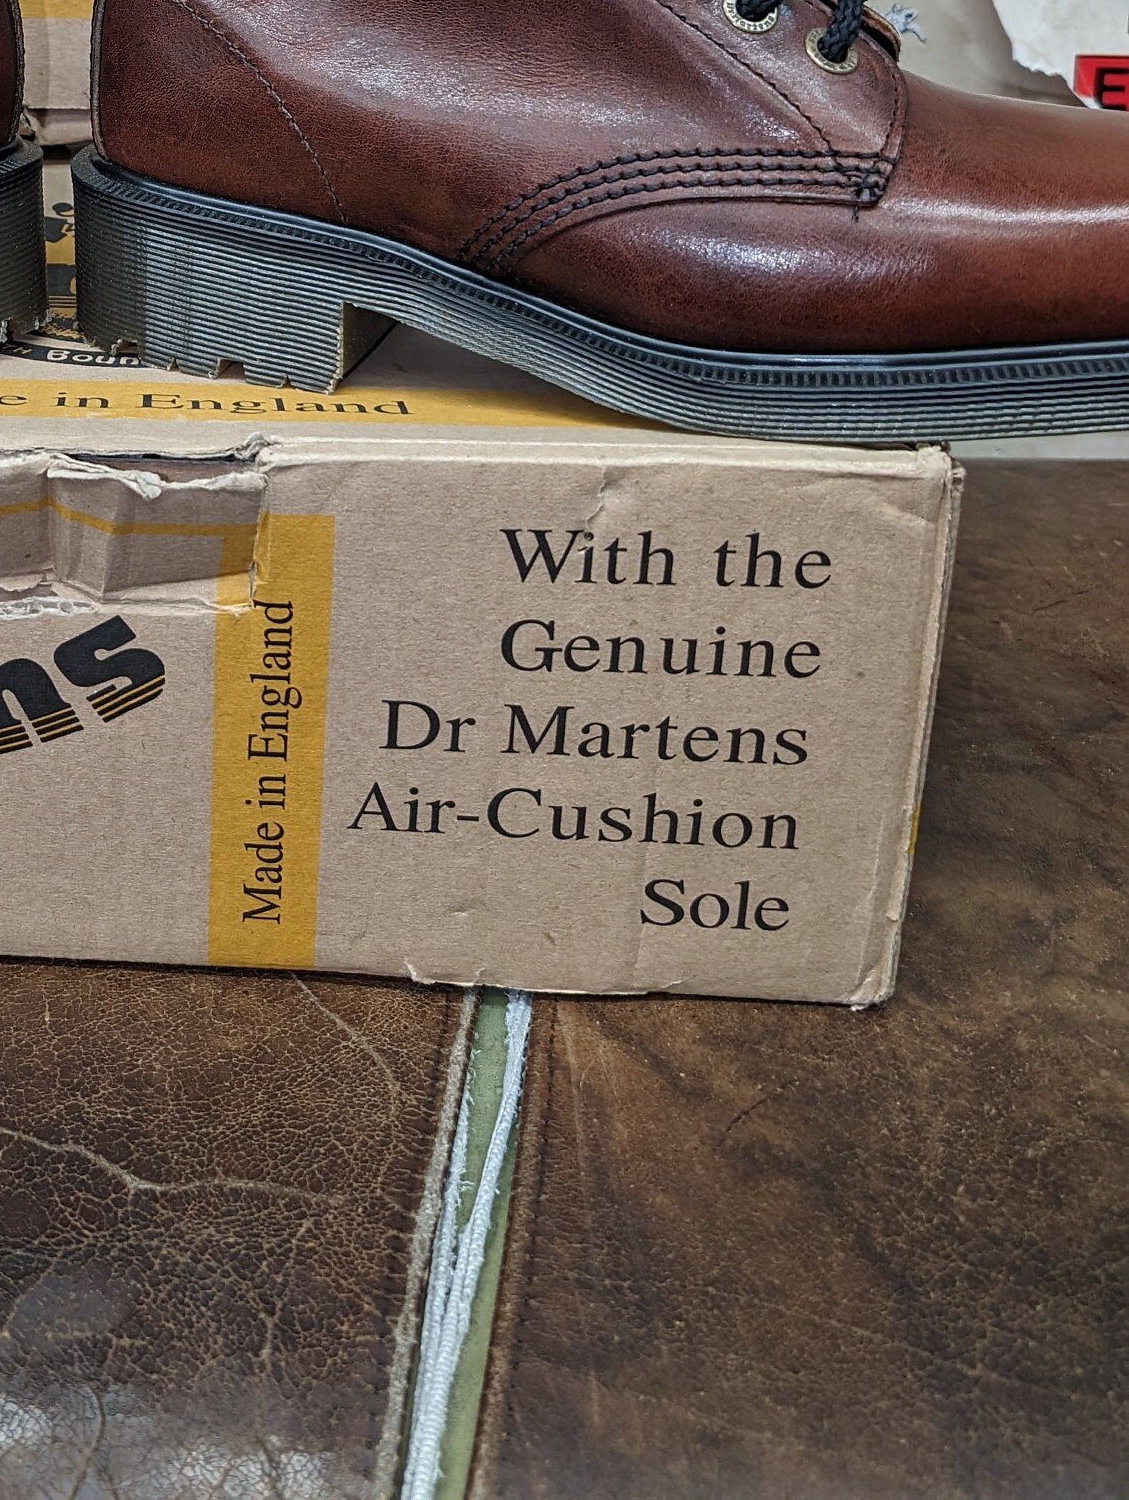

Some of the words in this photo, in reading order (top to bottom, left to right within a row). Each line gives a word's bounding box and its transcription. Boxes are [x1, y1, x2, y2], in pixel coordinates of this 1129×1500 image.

[55, 391, 110, 409] in
[137, 393, 414, 416] England
[499, 528, 677, 586] With
[712, 531, 833, 590] the
[500, 618, 822, 679] Genuine
[247, 599, 303, 762] England
[378, 699, 477, 754] Dr
[500, 703, 810, 767] Martens
[245, 773, 287, 811] in
[348, 781, 800, 851] Air-Cushion
[241, 821, 285, 925] Made
[639, 878, 791, 933] Sole
